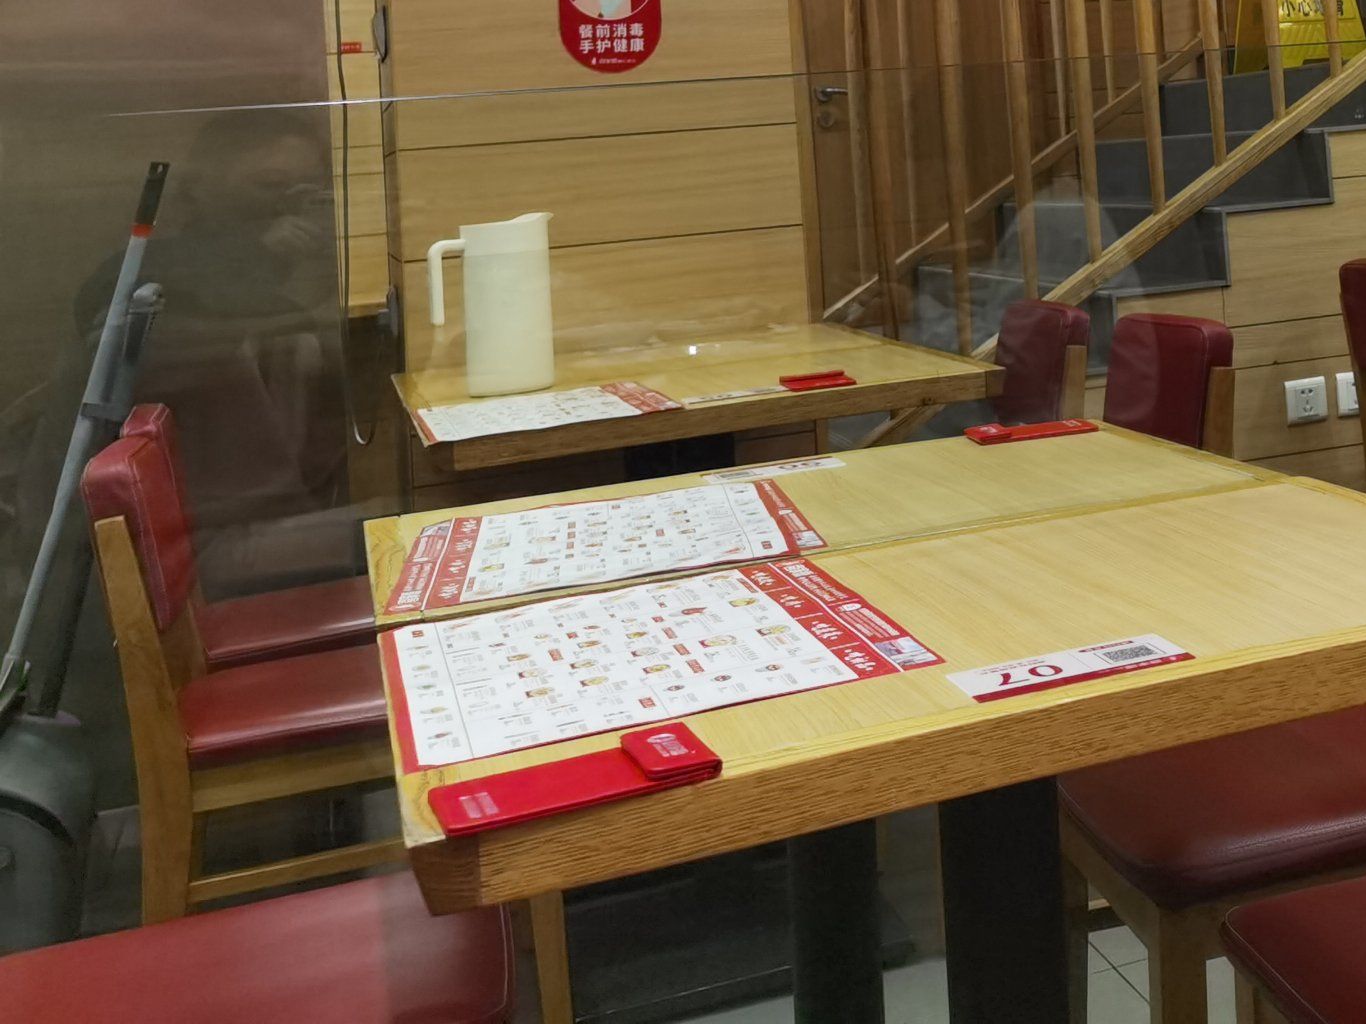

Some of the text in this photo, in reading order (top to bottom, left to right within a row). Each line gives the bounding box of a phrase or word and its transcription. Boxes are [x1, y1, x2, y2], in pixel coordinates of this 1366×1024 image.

[579, 23, 644, 39] 餐前消毒
[579, 38, 645, 54] 手护健康
